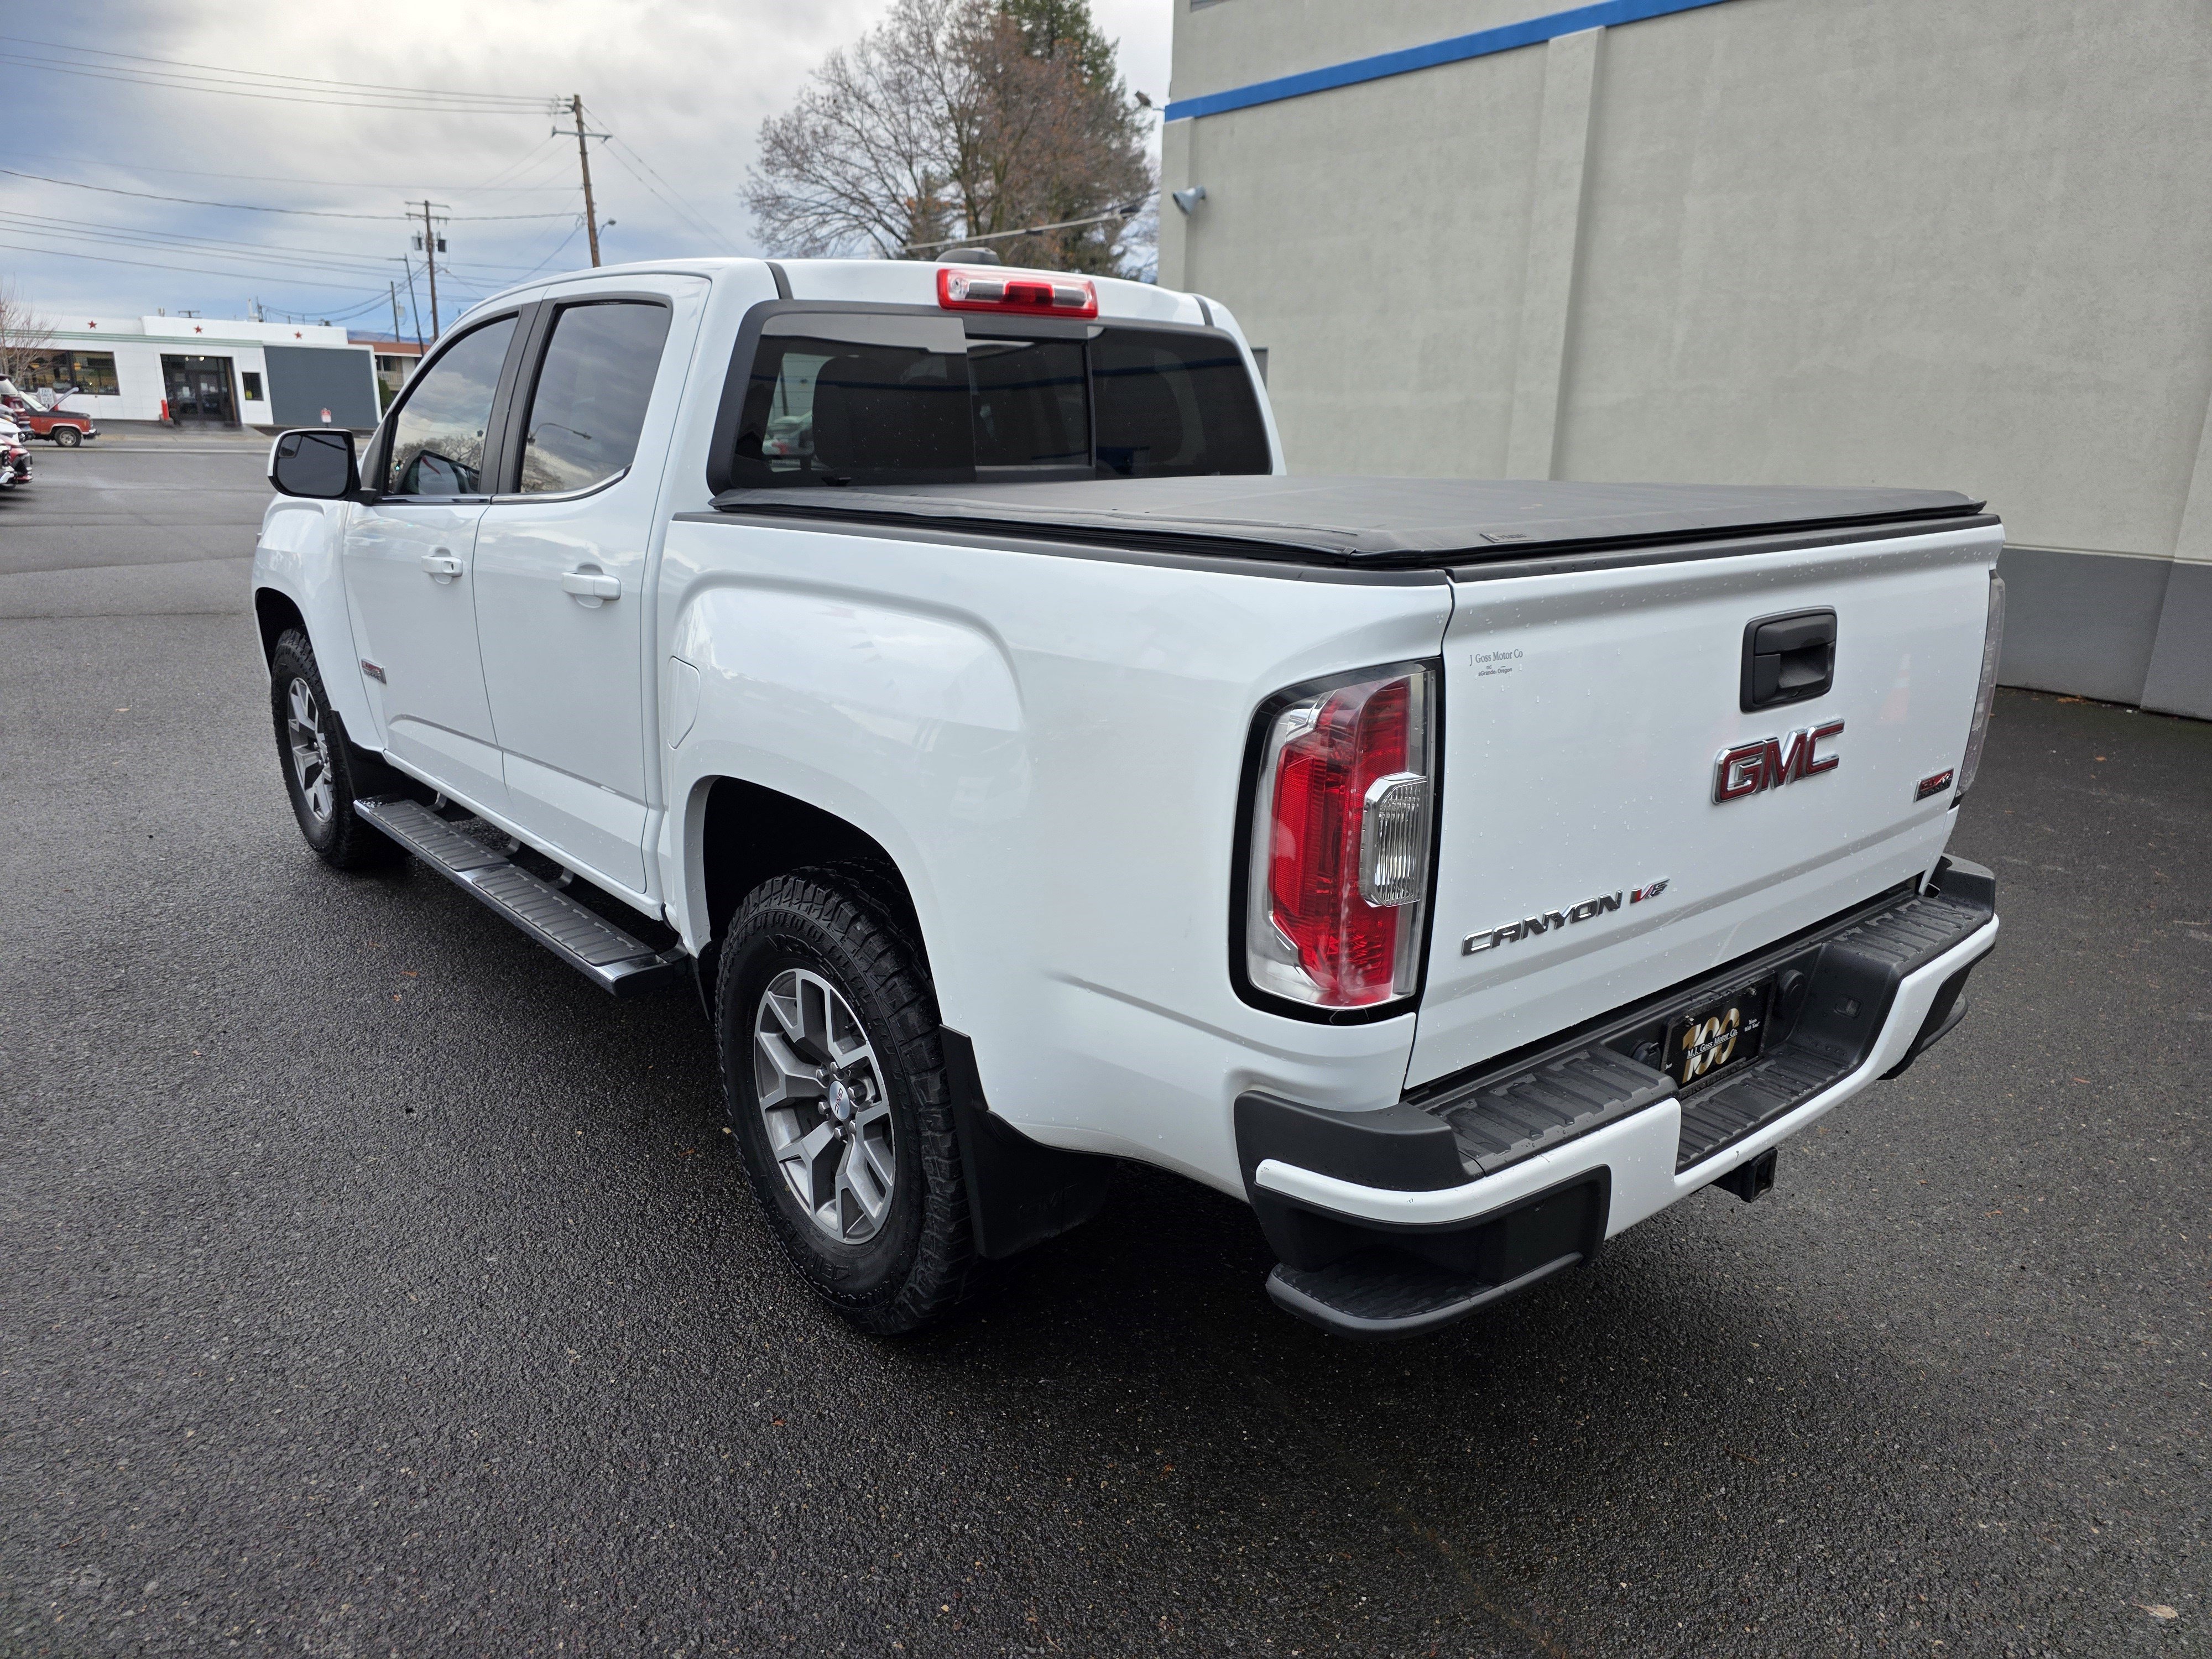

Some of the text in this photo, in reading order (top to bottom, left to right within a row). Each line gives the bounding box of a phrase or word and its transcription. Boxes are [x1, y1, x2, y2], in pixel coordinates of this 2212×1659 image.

[1469, 649, 1524, 666] J Goss Motor Co
[1711, 718, 1845, 806] GMC
[1462, 878, 1671, 956] CANYON V6
[1687, 1028, 1738, 1058] M.J. Goss Motor Co.
[834, 1088, 843, 1114] GMC
